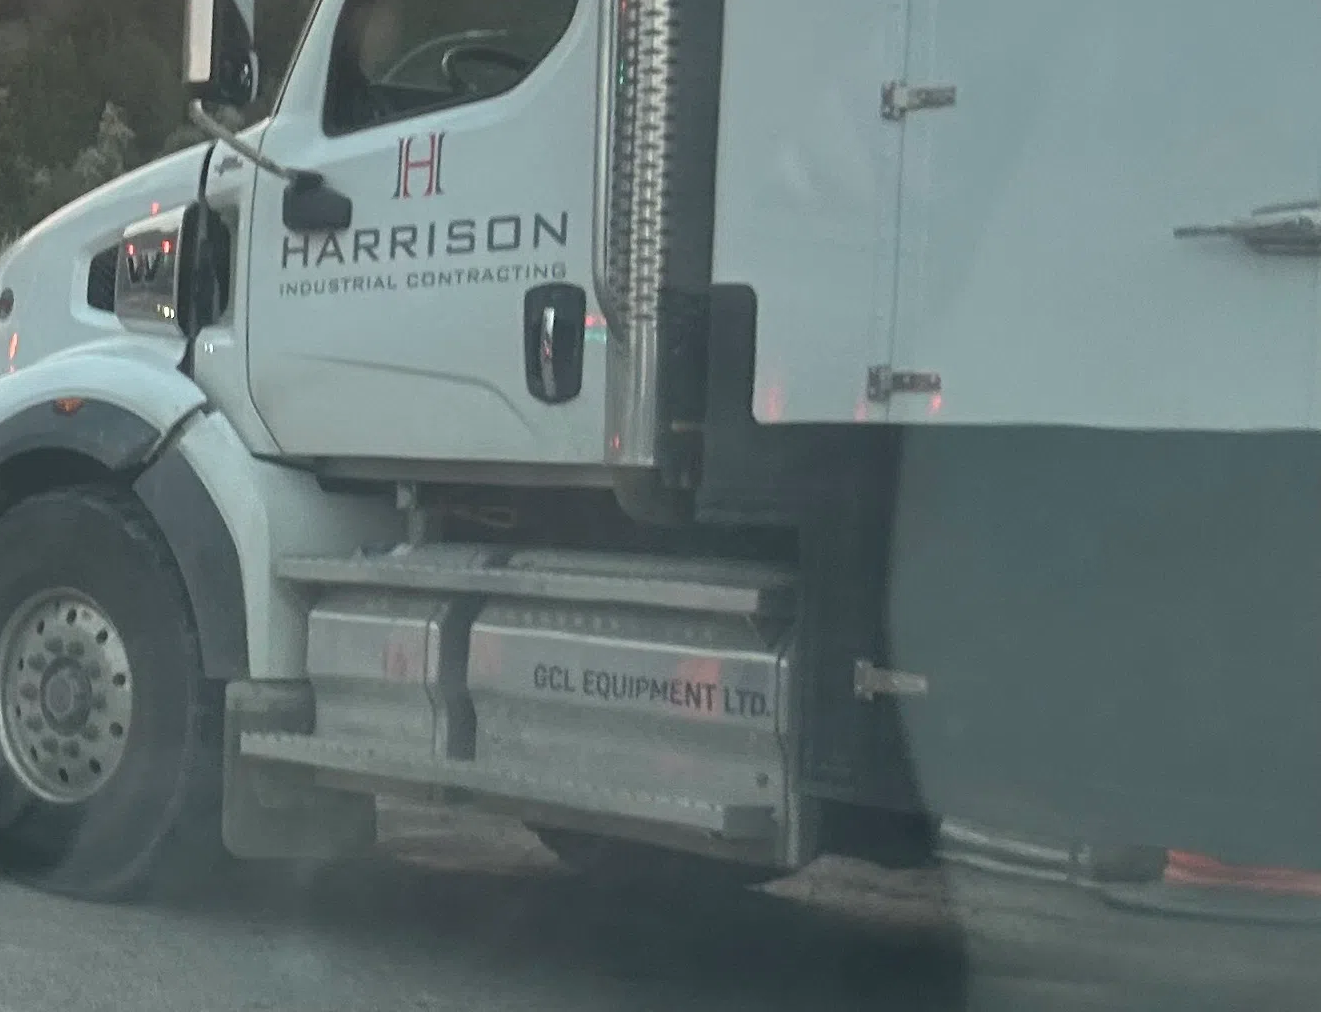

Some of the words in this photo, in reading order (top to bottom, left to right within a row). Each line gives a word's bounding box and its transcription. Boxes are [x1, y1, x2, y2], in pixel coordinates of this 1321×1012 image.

[281, 211, 569, 269] HARRISON
[279, 274, 398, 297] INDUSTRIAL
[406, 261, 567, 289] CONTRACTING
[534, 662, 576, 693] GCL
[582, 668, 717, 712] EQUIPMENT
[723, 686, 771, 717] LTD.
